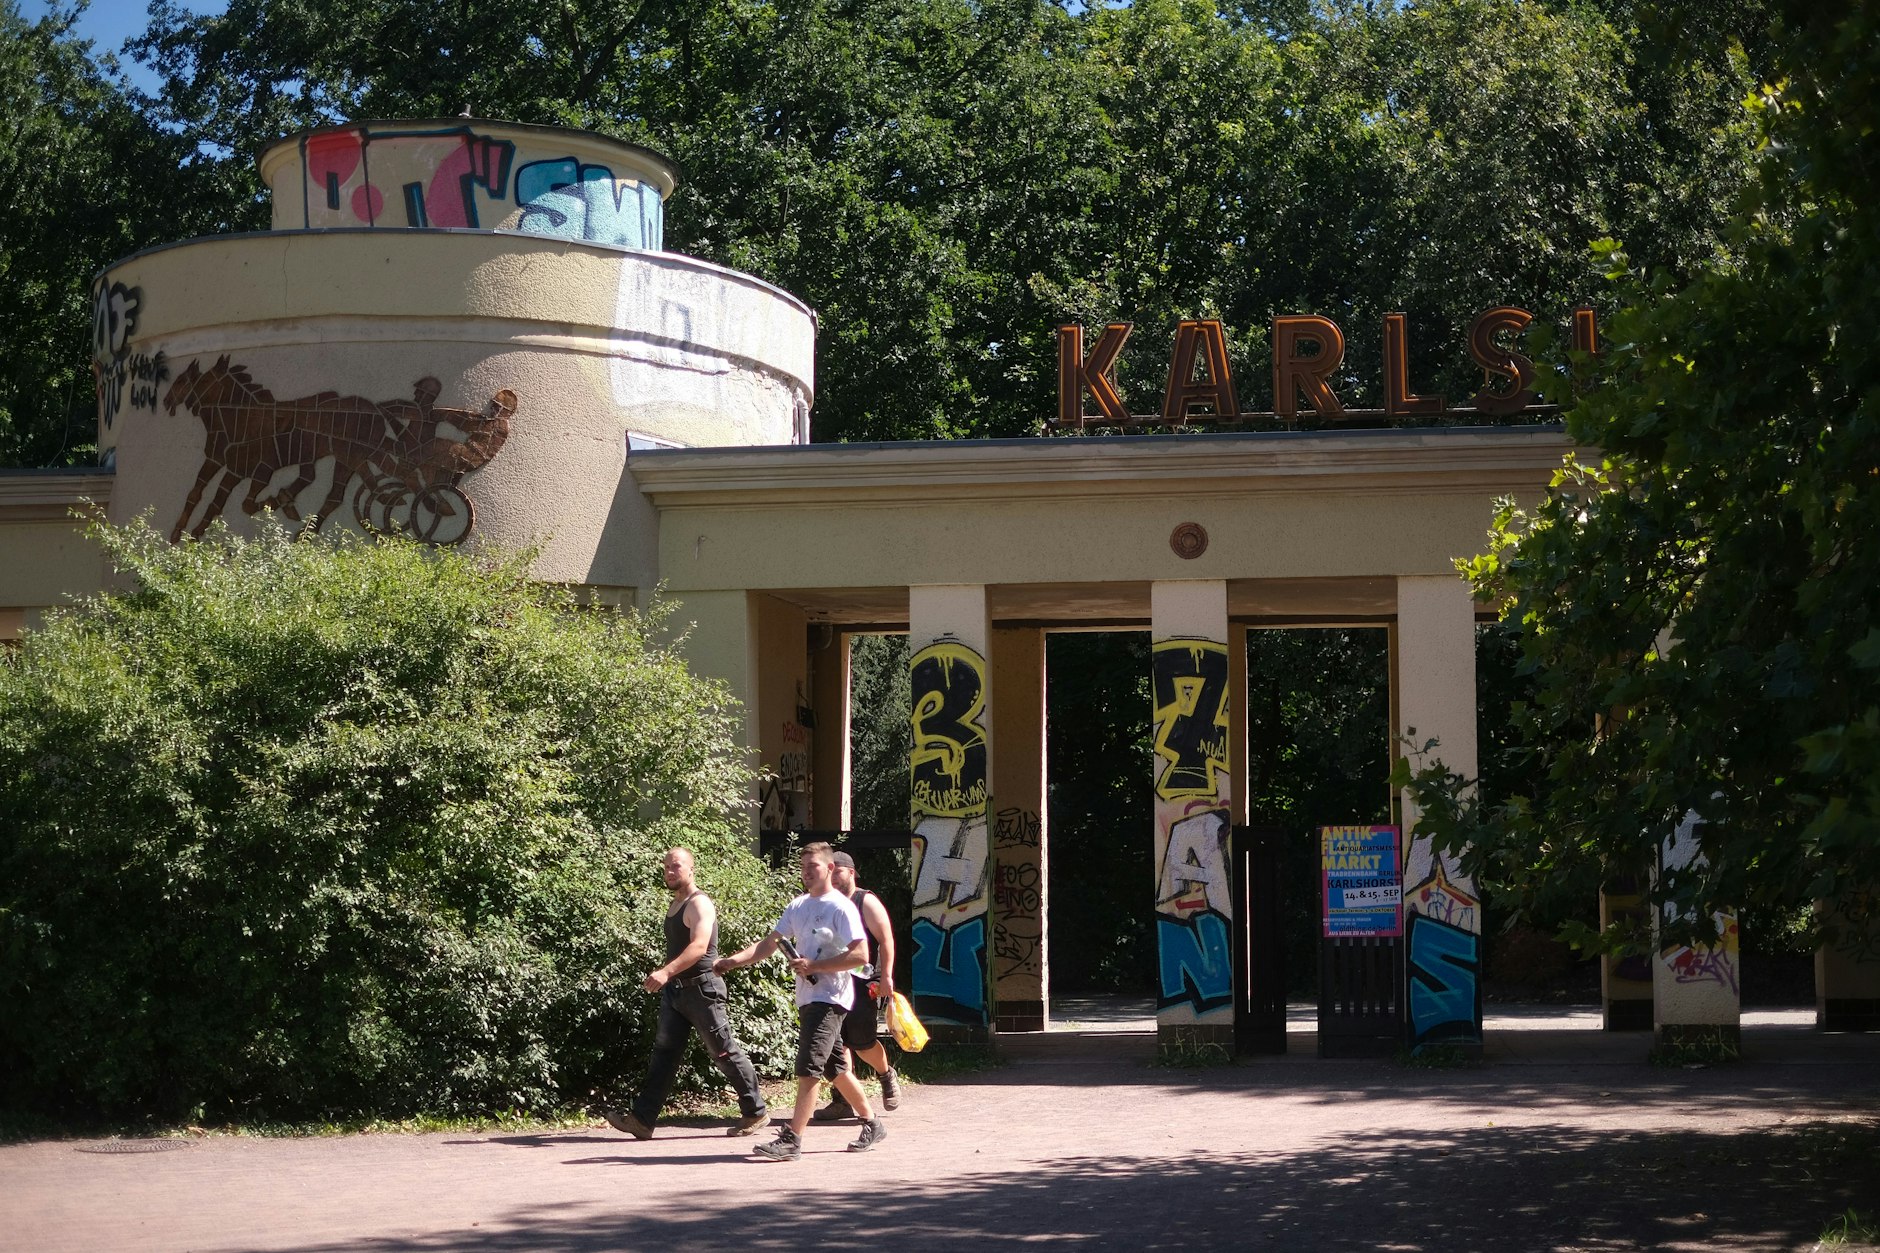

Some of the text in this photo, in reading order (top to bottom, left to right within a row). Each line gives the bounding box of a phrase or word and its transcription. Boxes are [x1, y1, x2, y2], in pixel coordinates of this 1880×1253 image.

[1321, 826, 1378, 840] ANTIK-
[1322, 854, 1382, 869] MARKT
[1328, 878, 1401, 888] KARLSHORST
[1383, 889, 1399, 897] SEP
